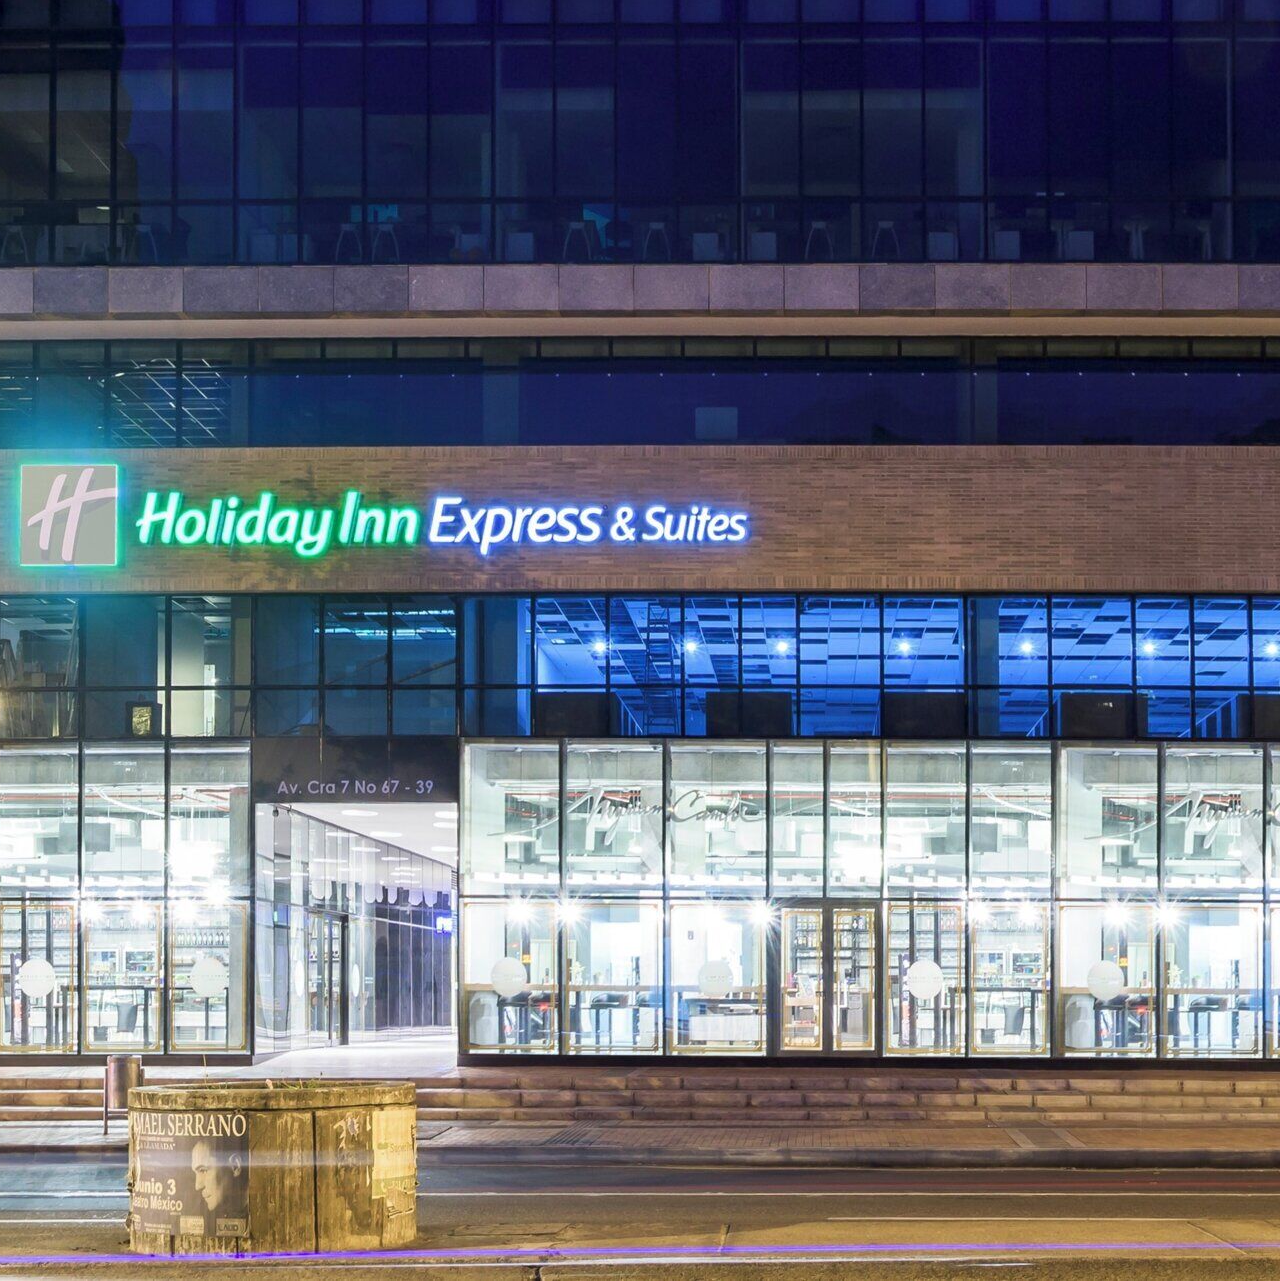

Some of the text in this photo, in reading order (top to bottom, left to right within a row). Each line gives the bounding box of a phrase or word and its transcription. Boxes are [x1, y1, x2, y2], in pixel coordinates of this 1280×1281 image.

[135, 491, 748, 557] Holiday Inn Express & Suites
[277, 780, 302, 794] Av.
[307, 780, 336, 794] Cra
[341, 780, 350, 794] 7
[355, 780, 377, 794] No
[381, 780, 400, 794] 67
[415, 780, 434, 794] 39
[167, 1112, 247, 1137] SERRANO
[167, 1178, 177, 1196] 3
[150, 1195, 183, 1211] México
